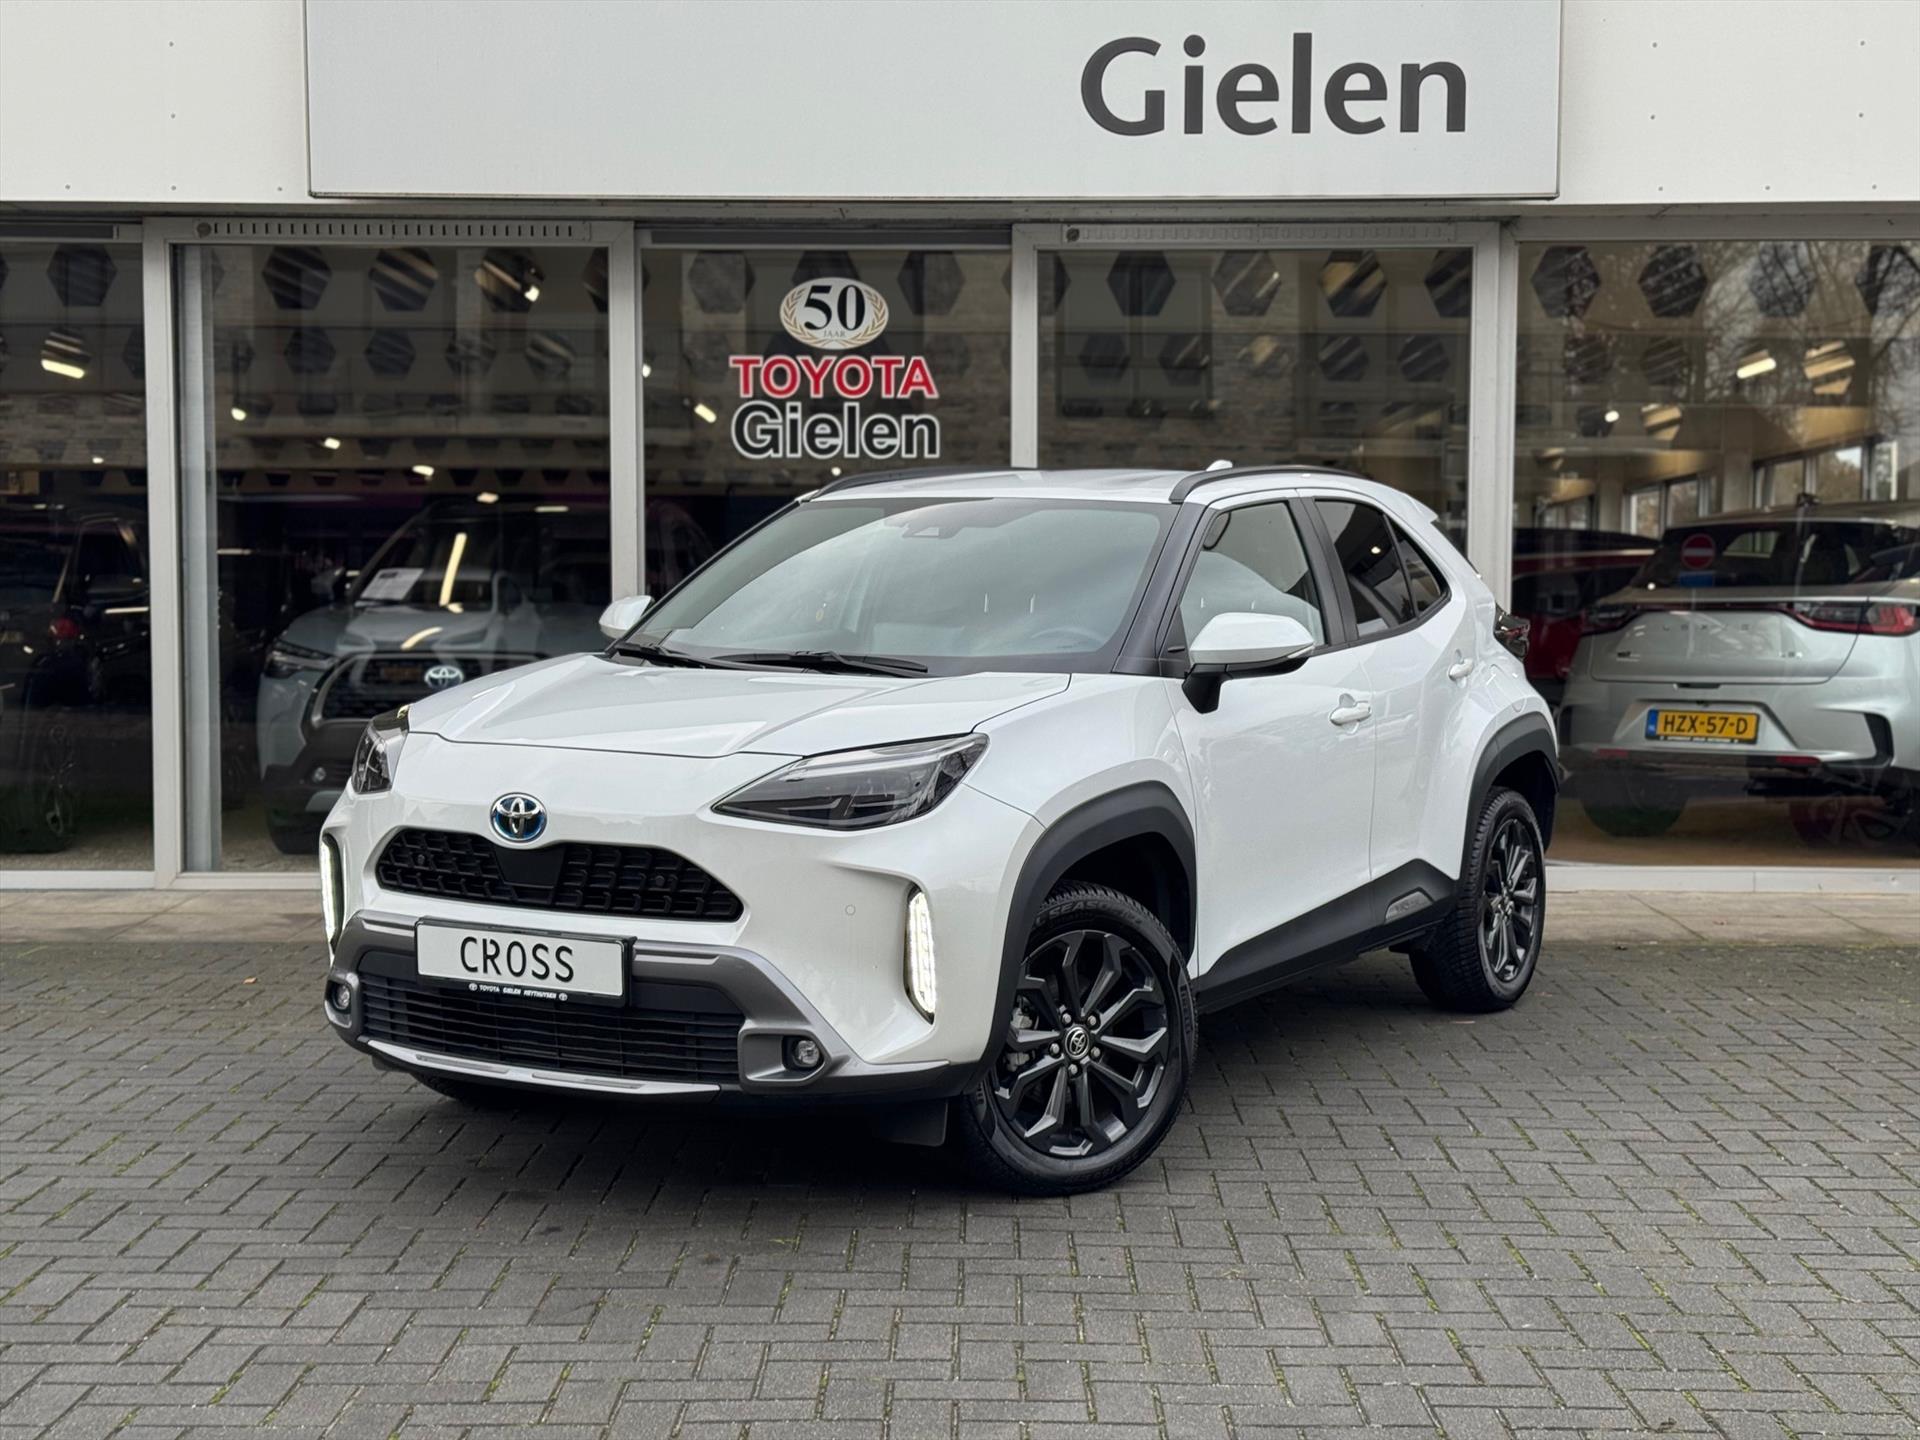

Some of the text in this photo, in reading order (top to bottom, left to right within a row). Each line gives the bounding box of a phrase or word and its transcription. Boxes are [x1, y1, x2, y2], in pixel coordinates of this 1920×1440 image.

[1081, 32, 1467, 136] Gielen
[803, 285, 866, 331] 50
[823, 330, 846, 338] JAAR
[729, 355, 940, 399] TOYOTA
[731, 400, 940, 459] Gielen
[1663, 714, 1748, 735] HZX-57-D
[460, 936, 574, 983] CROSS
[480, 984, 500, 993] TOYOTA
